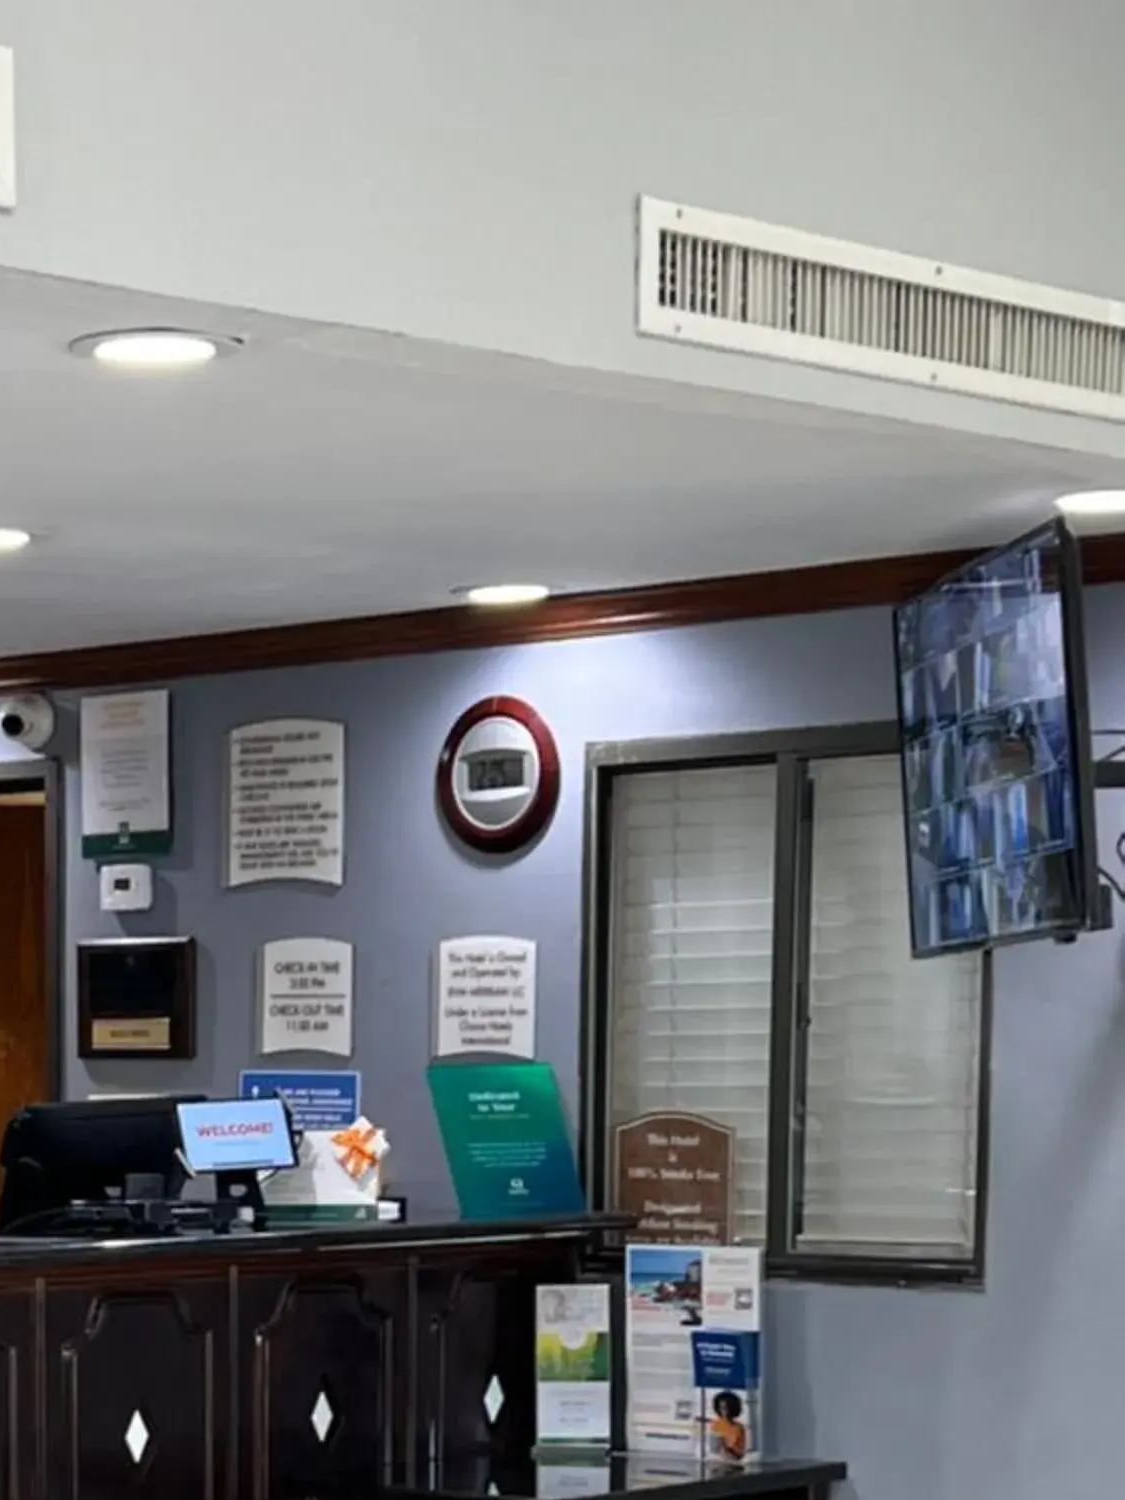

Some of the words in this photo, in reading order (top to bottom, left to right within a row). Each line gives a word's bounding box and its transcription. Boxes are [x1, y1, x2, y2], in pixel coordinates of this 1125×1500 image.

[274, 961, 304, 974] CHECK
[321, 960, 341, 974] TIME
[268, 1004, 300, 1017] CHECK
[302, 1004, 321, 1017] OUT
[324, 1003, 345, 1017] TIME
[197, 1121, 273, 1137] WELCOME!
